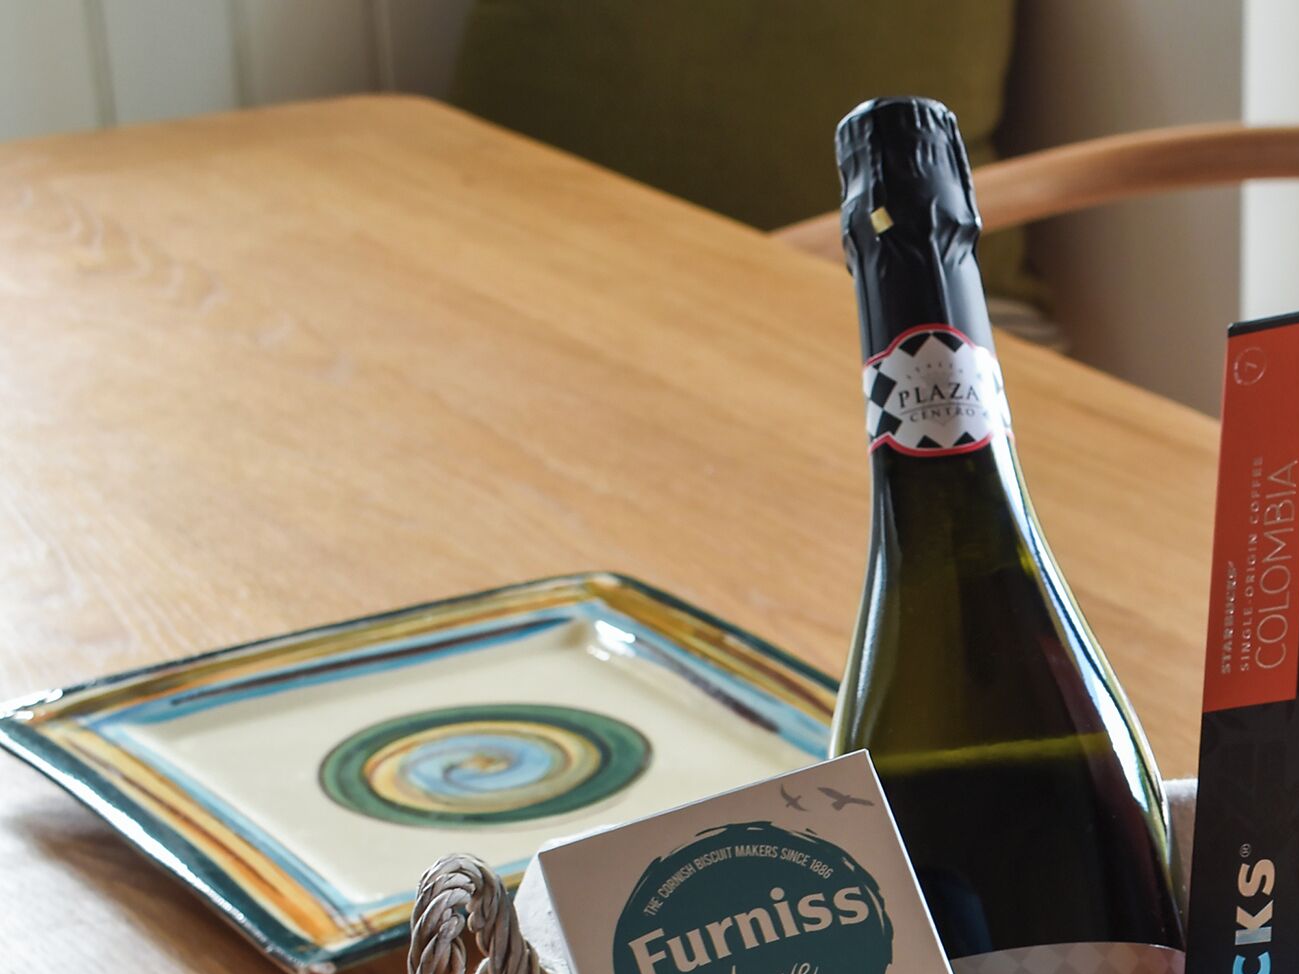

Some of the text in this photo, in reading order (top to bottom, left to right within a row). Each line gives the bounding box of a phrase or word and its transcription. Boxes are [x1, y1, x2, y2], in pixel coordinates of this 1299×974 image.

[898, 381, 980, 409] PLAZA
[909, 406, 976, 422] CENTRO
[1255, 460, 1299, 669] COLOMBIA
[643, 844, 835, 917] THE CORNISH BISCUIT MAKERS SINCE 1886
